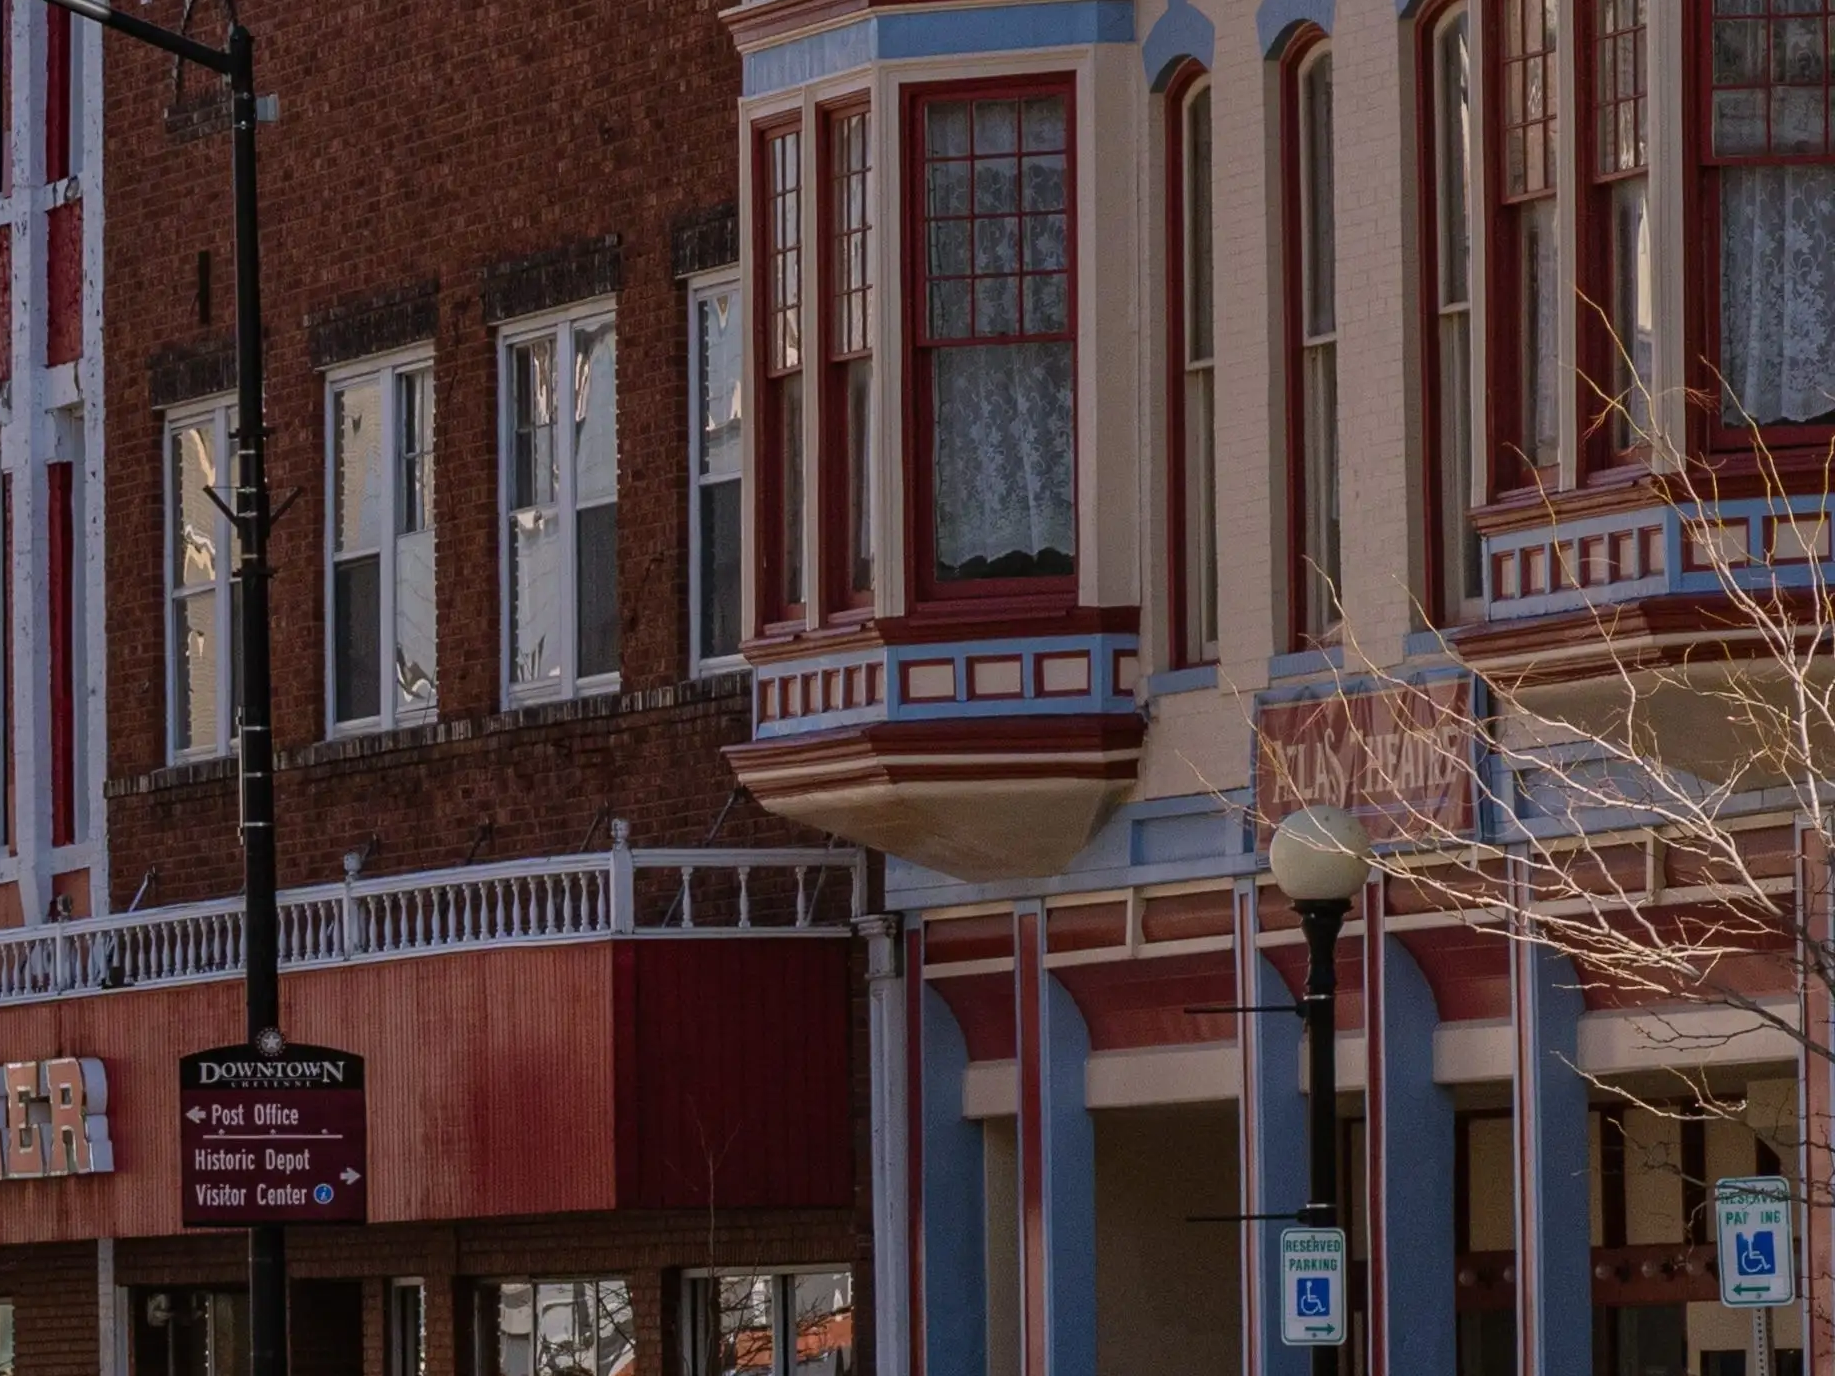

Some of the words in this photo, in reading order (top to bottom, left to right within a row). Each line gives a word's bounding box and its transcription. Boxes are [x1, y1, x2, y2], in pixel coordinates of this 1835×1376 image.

[1272, 728, 1346, 809] ATLAS
[199, 1061, 345, 1084] DOWNTOWN
[211, 1104, 245, 1125] Post
[254, 1103, 300, 1125] Office
[195, 1148, 256, 1171] Historic
[265, 1148, 311, 1175] Depot
[195, 1183, 247, 1207] Visitor
[256, 1183, 308, 1206] Center
[1286, 1239, 1341, 1253] RESERVED
[1289, 1258, 1338, 1272] PARKING
